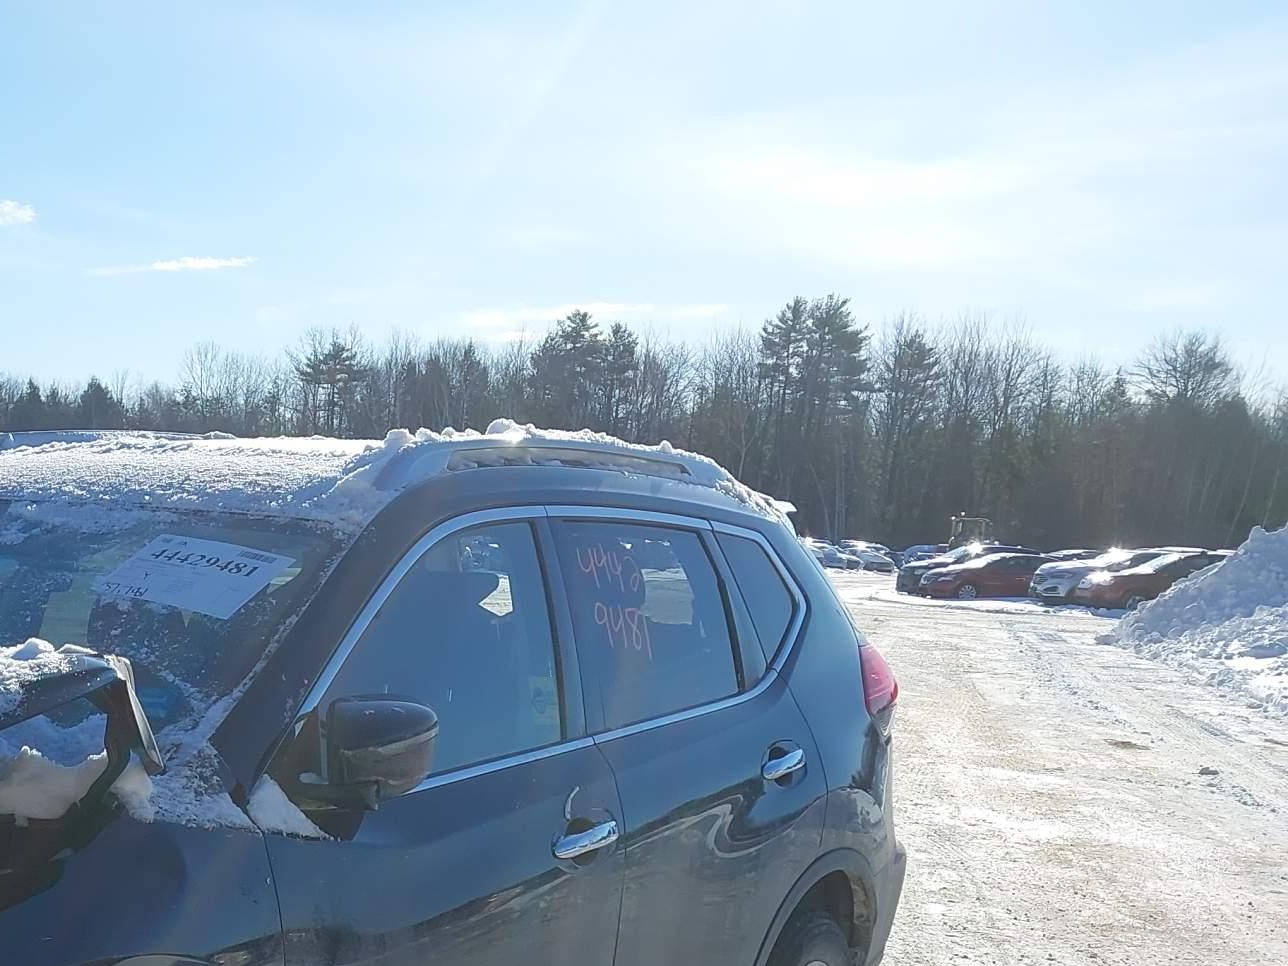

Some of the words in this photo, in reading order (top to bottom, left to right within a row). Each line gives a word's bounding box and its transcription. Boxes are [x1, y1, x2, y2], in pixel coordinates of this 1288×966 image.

[151, 549, 259, 577] 44429481
[576, 544, 641, 592] 4442
[594, 602, 653, 664] 9481
